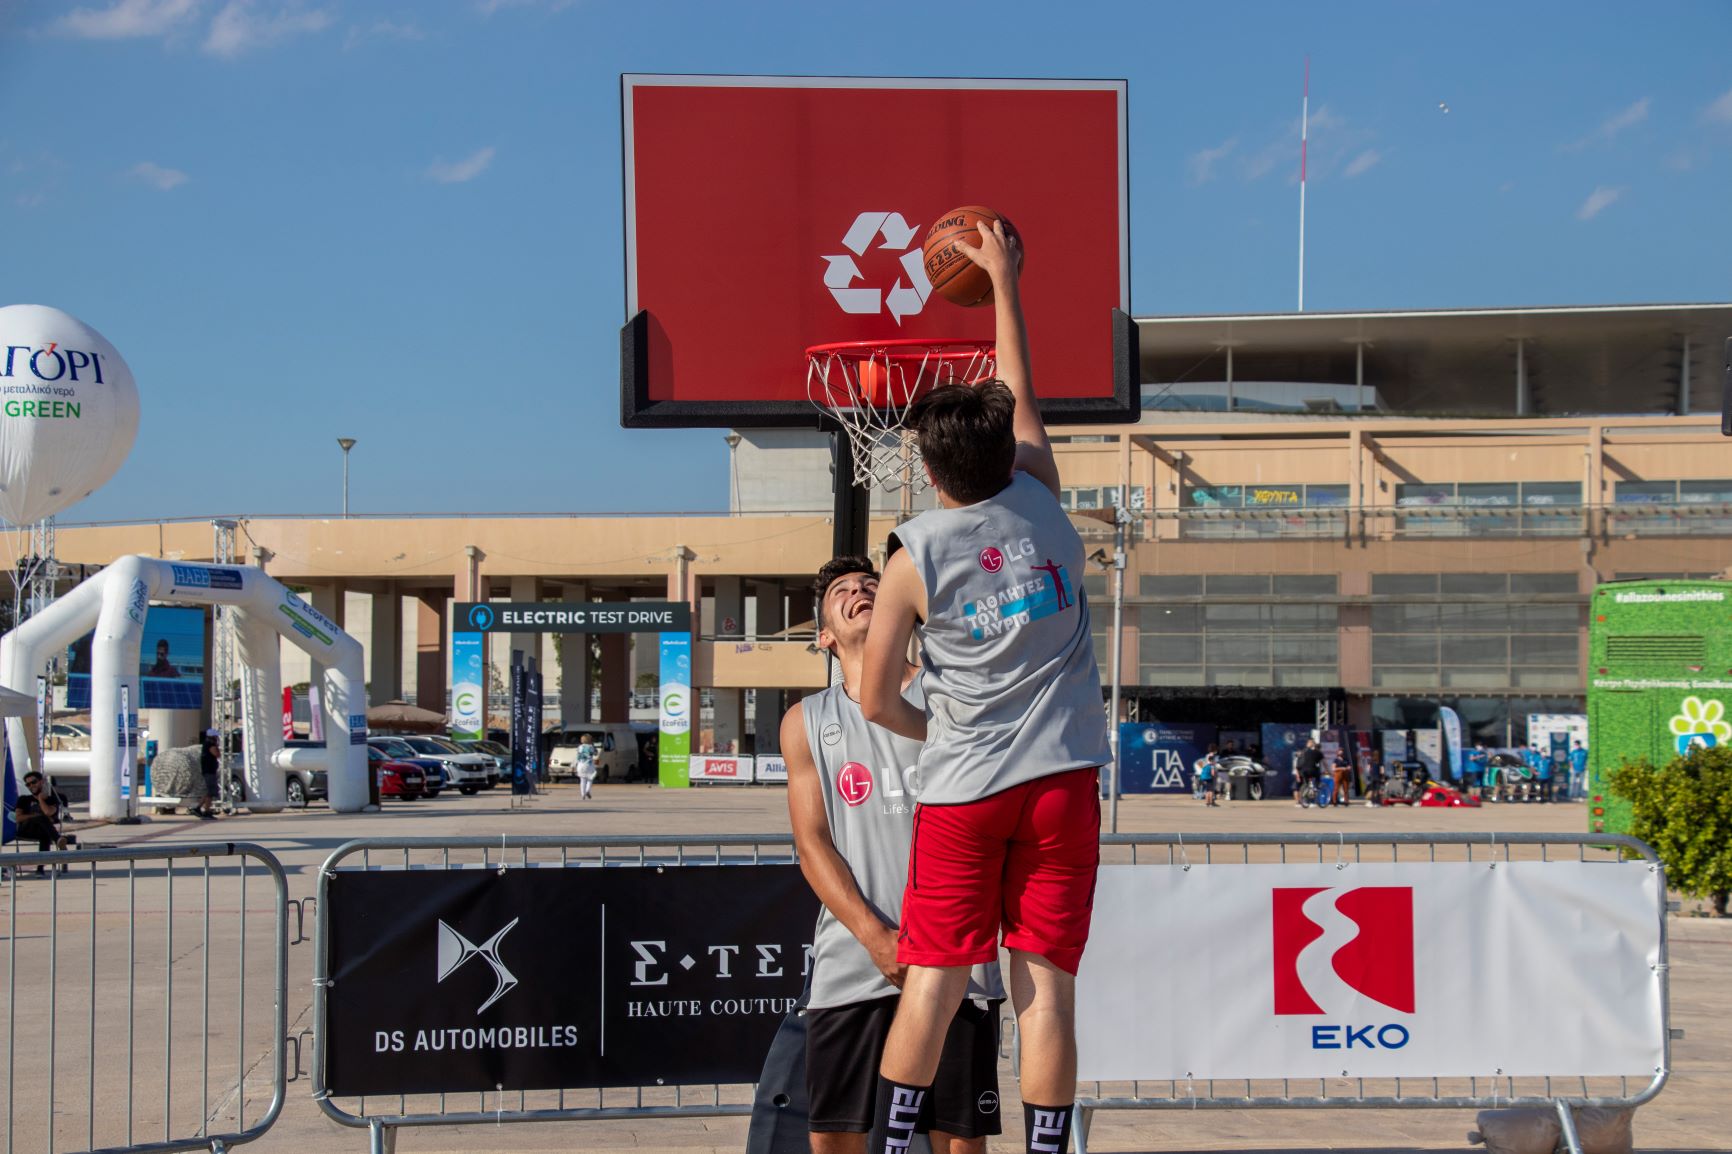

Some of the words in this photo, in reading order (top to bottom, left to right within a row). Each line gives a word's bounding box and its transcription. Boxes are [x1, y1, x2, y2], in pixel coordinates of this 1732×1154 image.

[53, 387, 75, 398] νερό
[5, 400, 81, 418] GREEN
[1005, 538, 1036, 562] LG
[502, 611, 586, 624] ELECTRIC
[590, 611, 625, 624] TEST
[628, 611, 673, 624] DRIVE
[661, 718, 688, 727] EcoFest
[709, 763, 734, 773] AVIS
[883, 804, 910, 815] Life's
[628, 1000, 702, 1017] HAUTE
[710, 998, 798, 1015] COUTUR
[375, 1031, 405, 1052] DS
[414, 1025, 578, 1051] AUTOMOBILES
[1312, 1023, 1410, 1050] EKO
